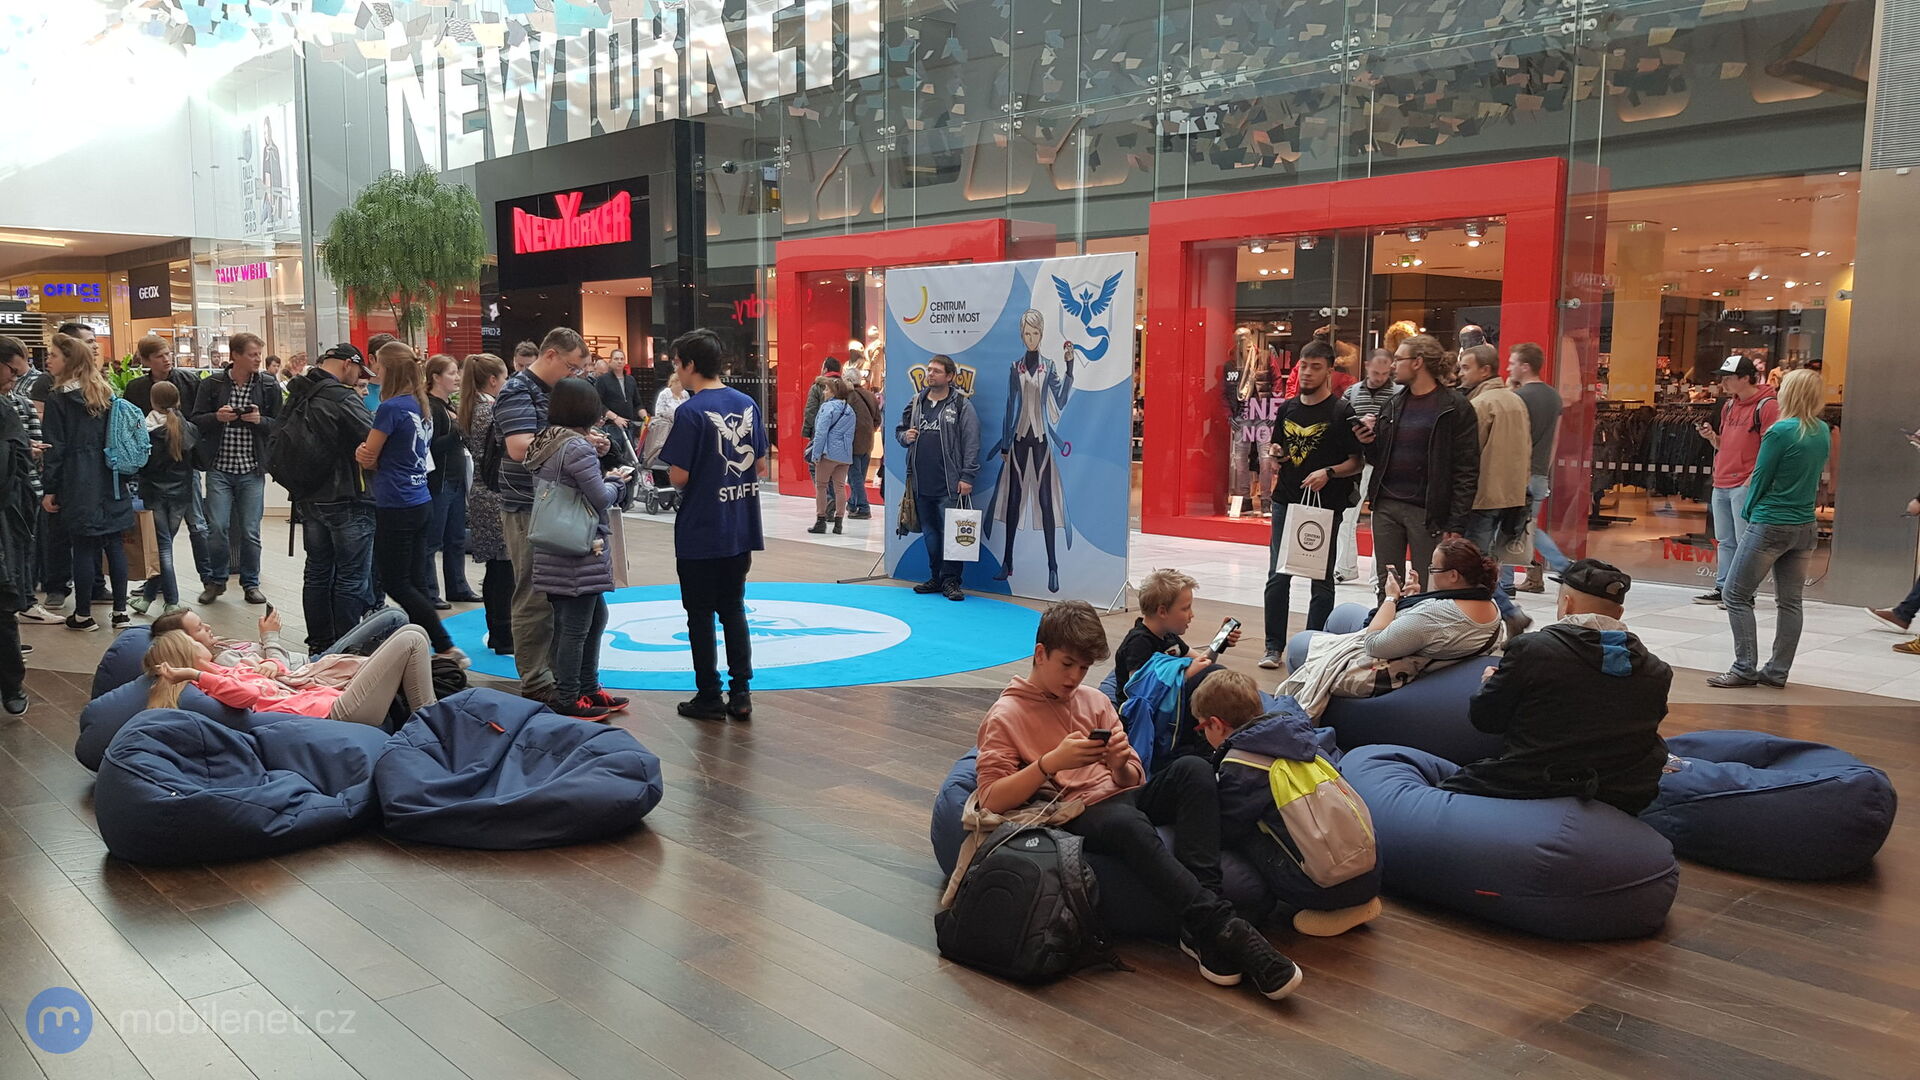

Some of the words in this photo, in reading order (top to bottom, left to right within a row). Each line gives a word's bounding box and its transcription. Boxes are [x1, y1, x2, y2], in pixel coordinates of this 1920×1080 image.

[43, 283, 100, 296] OFFICE
[138, 286, 160, 300] GEOX
[930, 300, 966, 312] CENTRUM
[929, 311, 955, 324] ČERNÝ
[957, 312, 981, 323] MOST
[1226, 371, 1239, 381] 399
[719, 481, 760, 502] STAFF
[960, 527, 972, 535] GO
